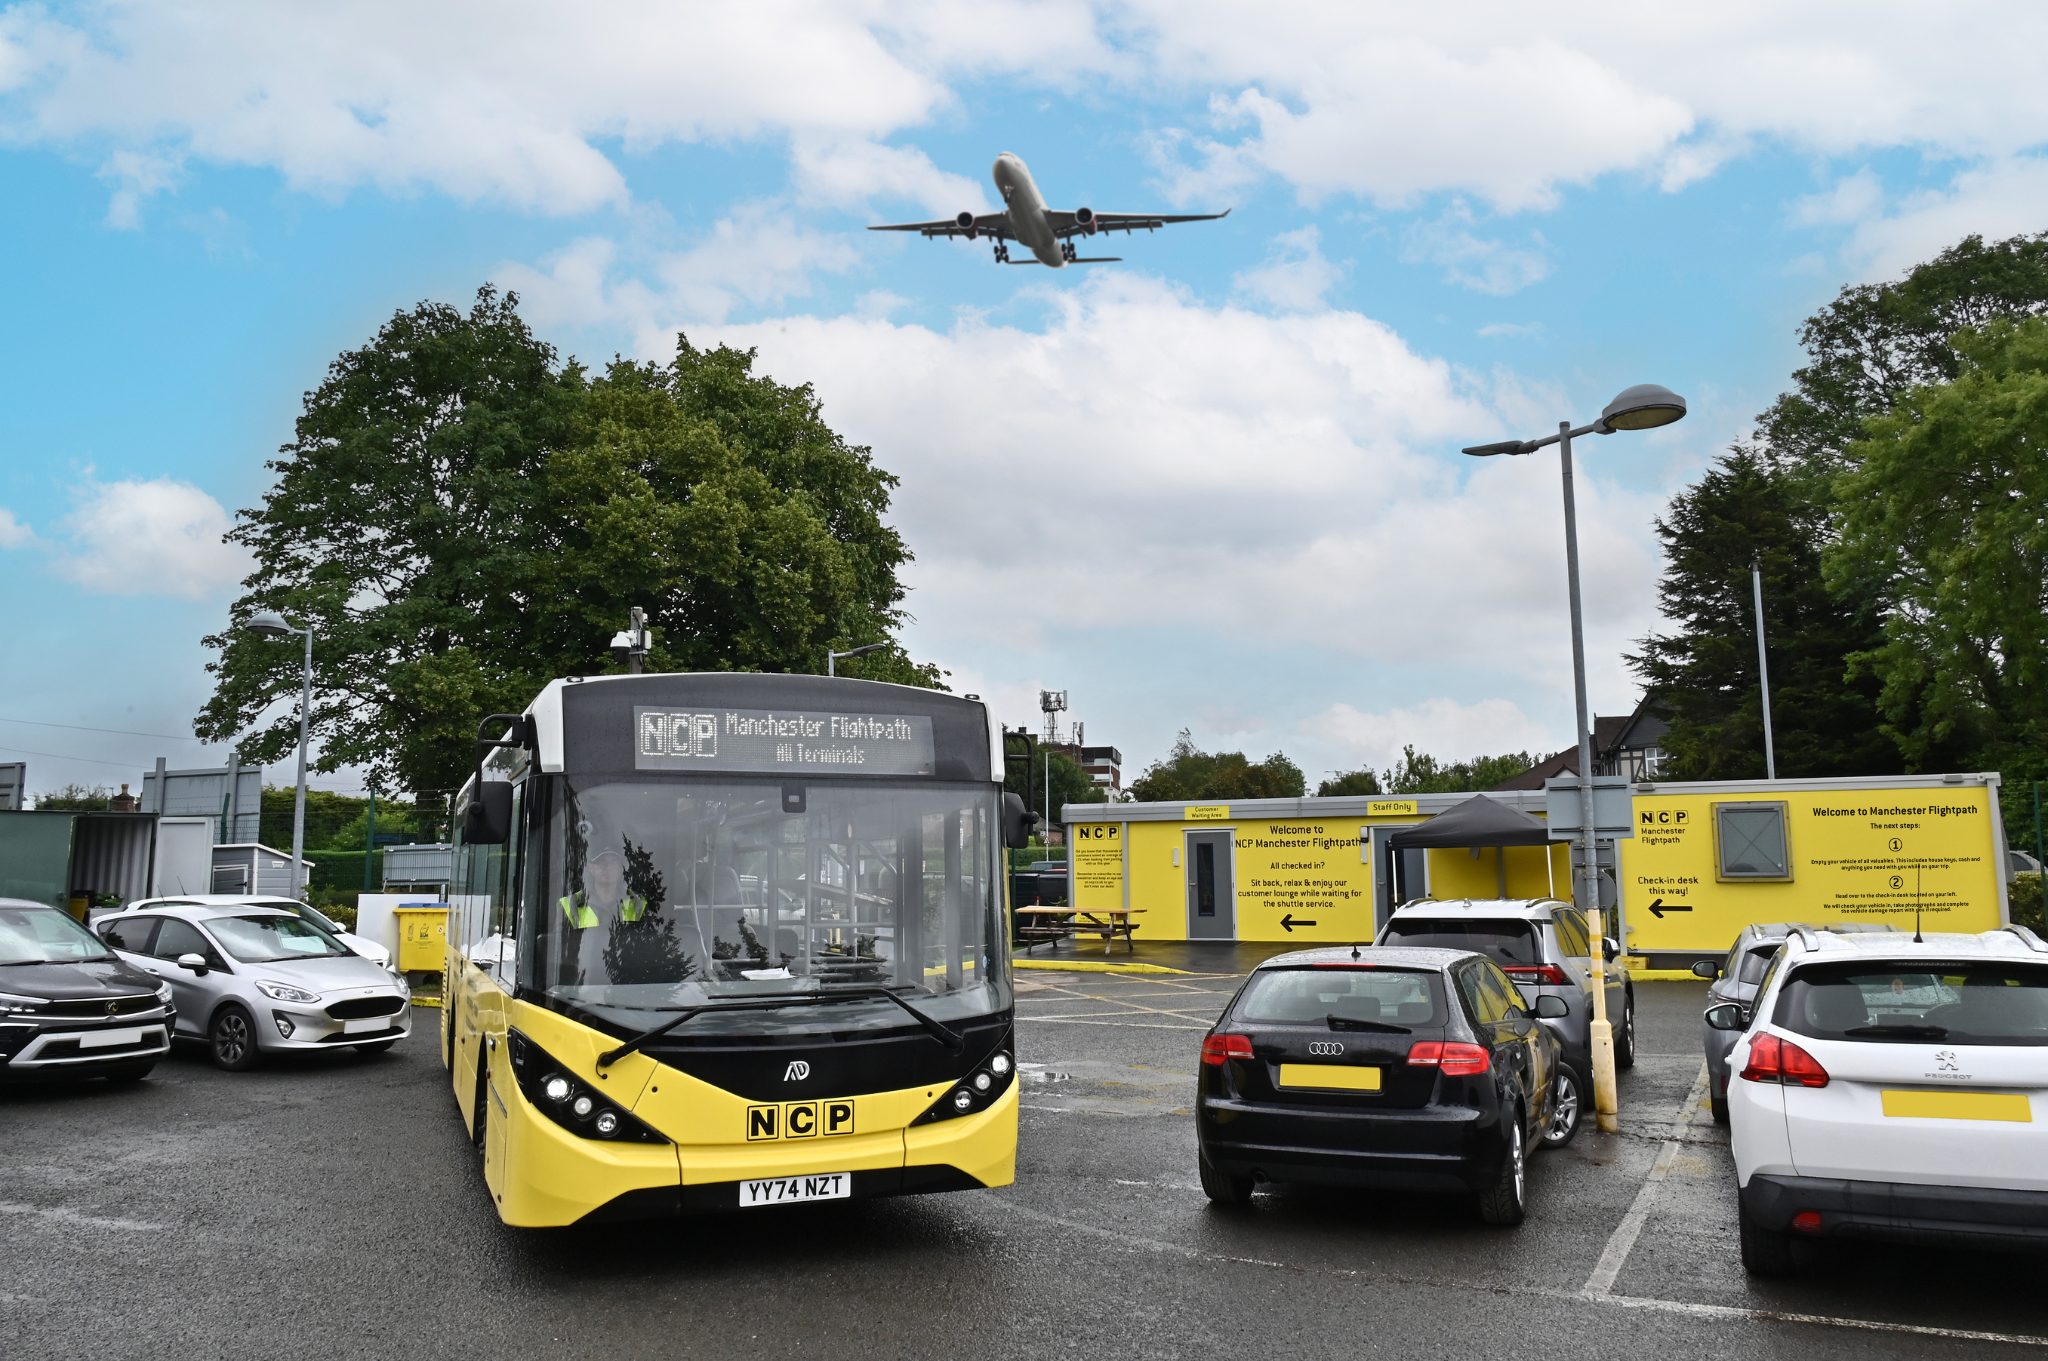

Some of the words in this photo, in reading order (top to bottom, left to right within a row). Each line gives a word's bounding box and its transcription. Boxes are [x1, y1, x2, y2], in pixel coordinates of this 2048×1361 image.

[642, 713, 716, 756] NCP
[726, 713, 824, 738] Manchester
[831, 717, 911, 740] Flightpath
[777, 744, 792, 762] All
[798, 744, 864, 764] Terminals
[1374, 804, 1392, 812] Staff
[1394, 803, 1412, 812] Only
[1813, 807, 1855, 816] Welcome
[1858, 808, 1868, 816] to
[1870, 806, 1926, 816] Manchester
[1928, 805, 1978, 817] Flightpath
[1641, 811, 1687, 824] NCP
[1080, 827, 1118, 839] NCP
[1270, 826, 1311, 834] Welcome
[1236, 839, 1253, 848] NCP
[1256, 839, 1310, 848] Manchester
[1313, 838, 1361, 849] Flightpath
[1642, 836, 1680, 845] Flightpath
[1262, 879, 1282, 887] back,
[1312, 880, 1332, 888] enjoy
[1274, 890, 1298, 899] lounge
[1322, 890, 1350, 899] waiting
[1668, 887, 1688, 896] way!
[750, 1104, 852, 1138] NCP
[749, 1179, 799, 1201] YY74
[805, 1176, 842, 1197] NZT
